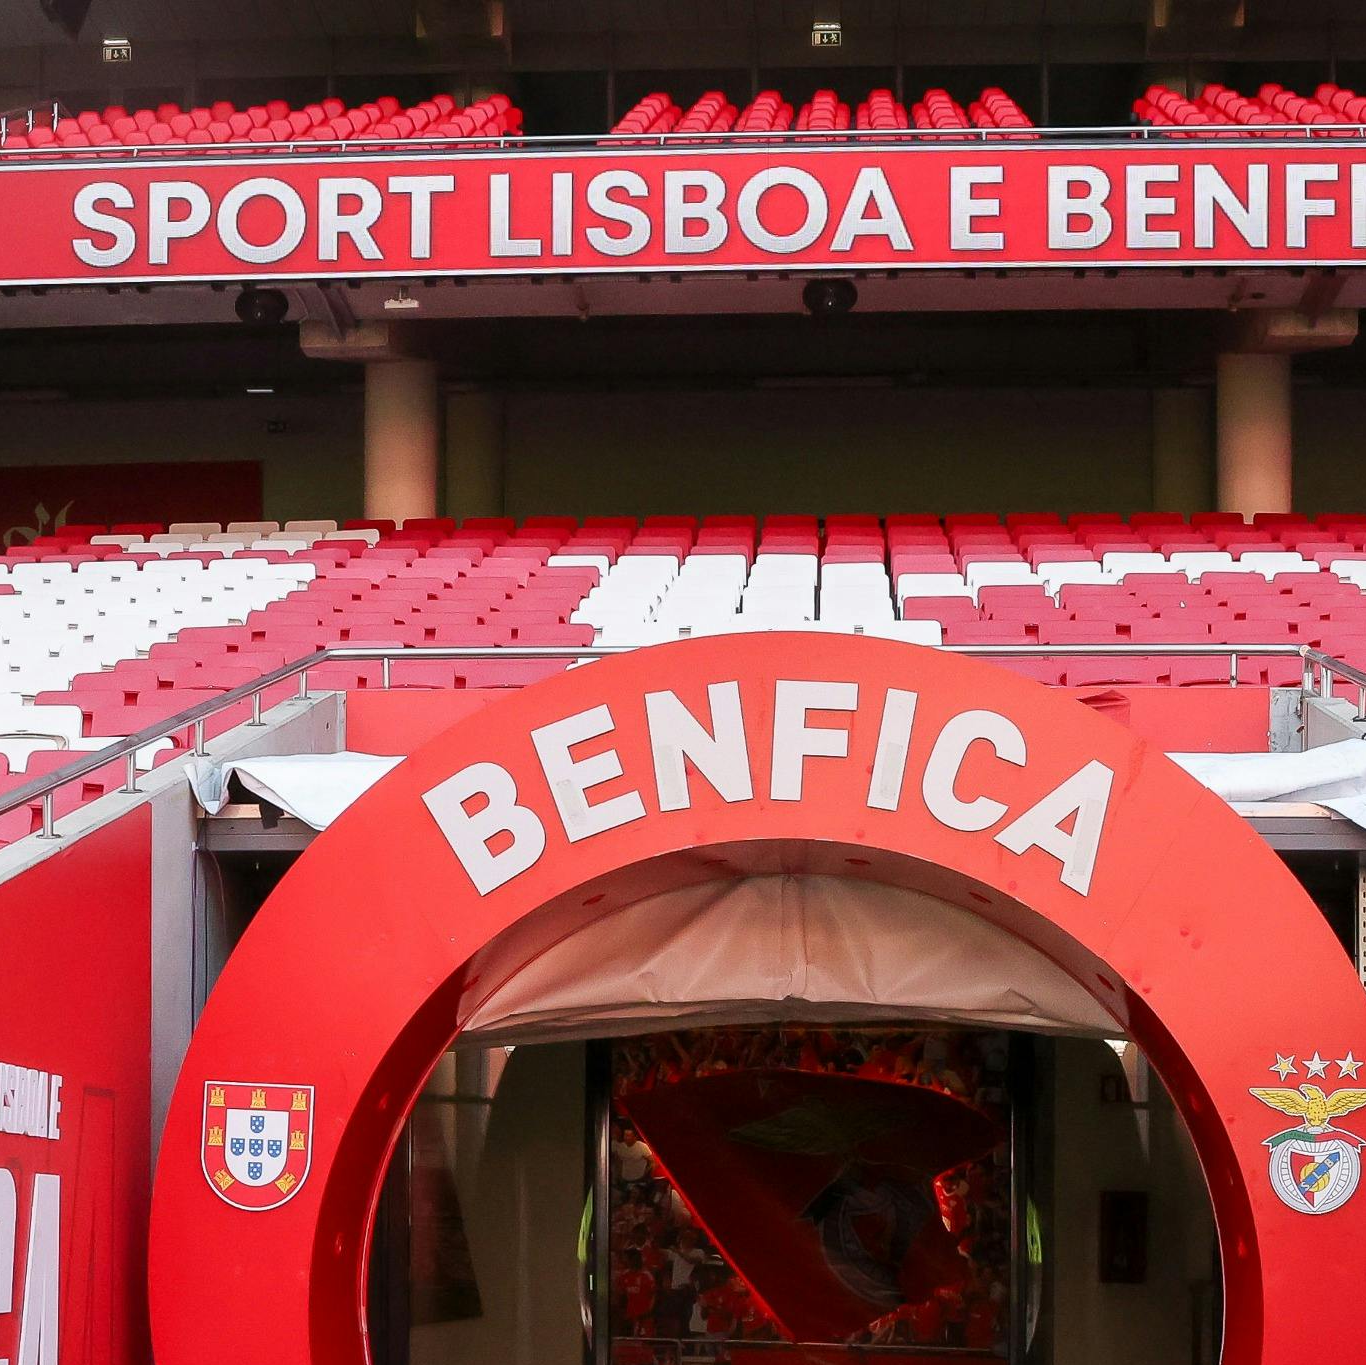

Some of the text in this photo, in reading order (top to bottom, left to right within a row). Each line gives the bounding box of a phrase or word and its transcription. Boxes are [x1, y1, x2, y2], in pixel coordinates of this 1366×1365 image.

[72, 174, 455, 267] SPORT
[489, 166, 914, 257] LISBOA
[950, 165, 1004, 251] E
[420, 679, 1115, 897] BENFICA
[47, 1074, 63, 1140] E
